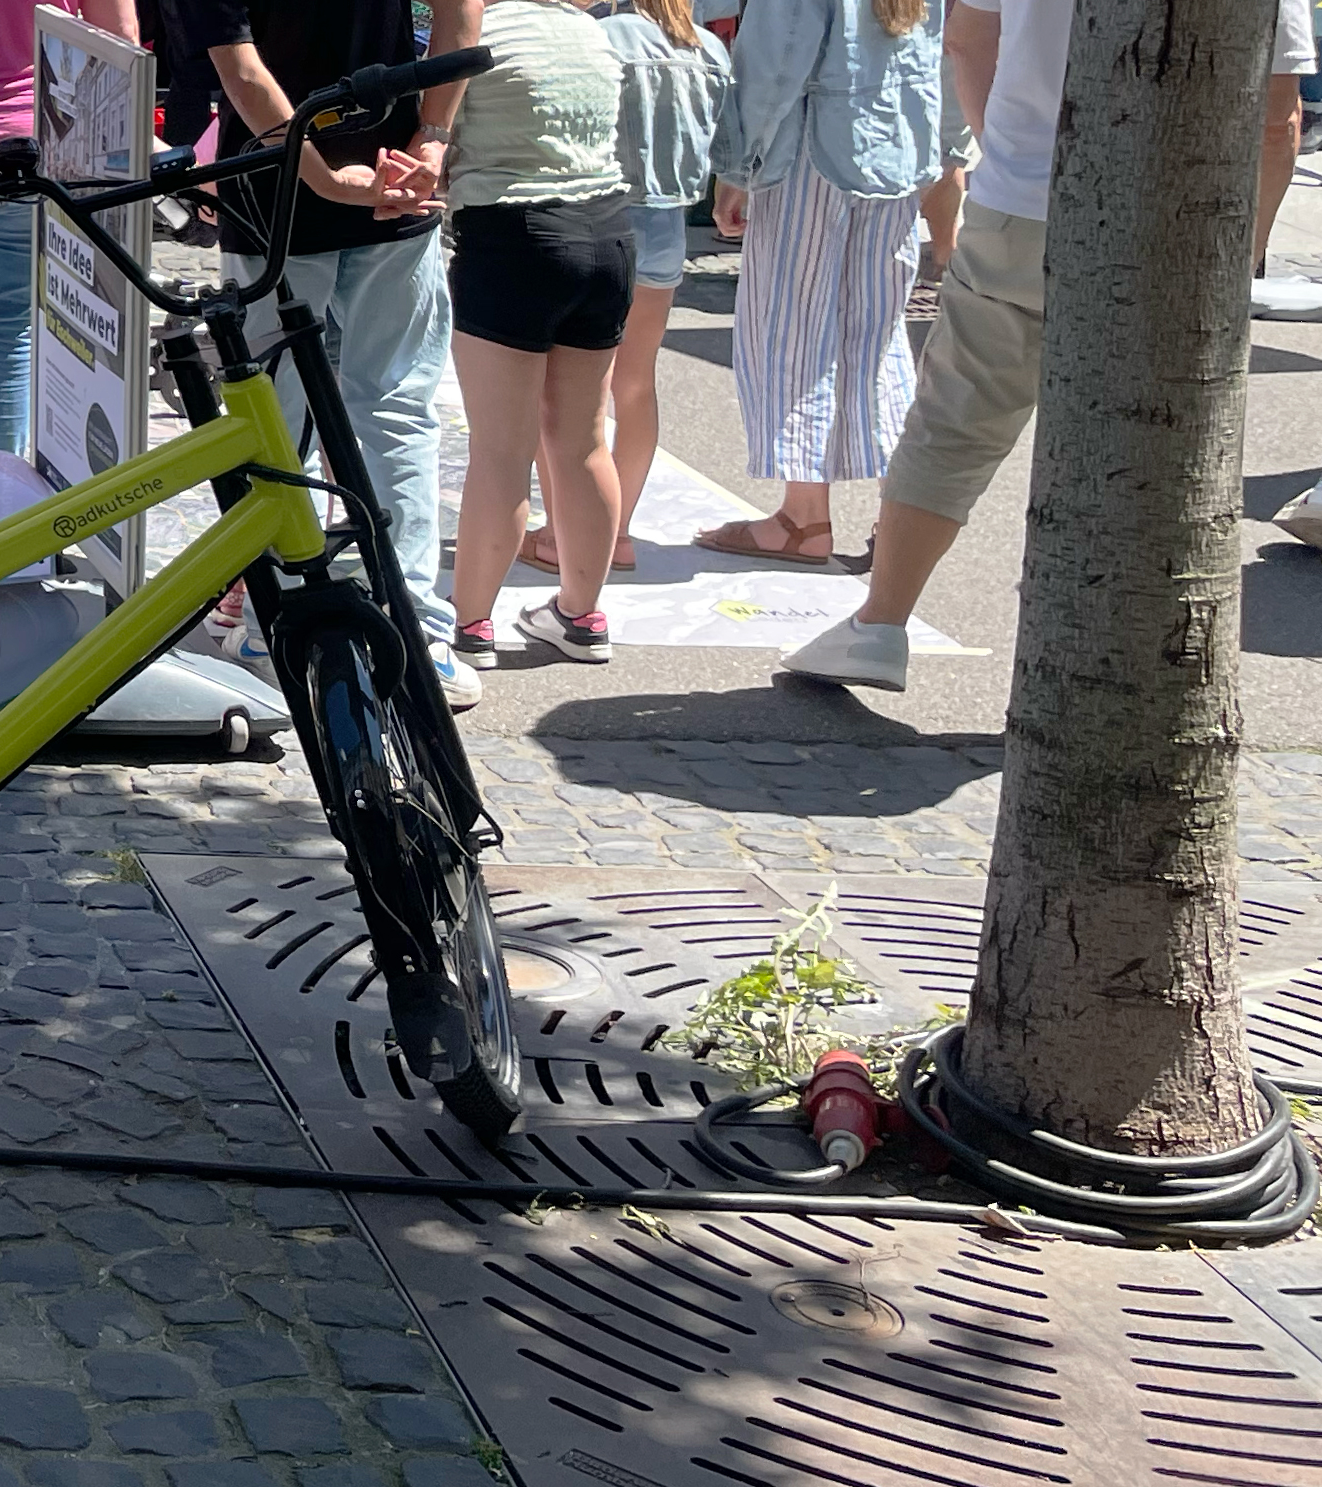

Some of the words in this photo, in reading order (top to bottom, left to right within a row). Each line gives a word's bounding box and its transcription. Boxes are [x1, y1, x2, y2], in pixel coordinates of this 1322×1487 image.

[48, 222, 67, 261] Ihre
[69, 236, 92, 281] Idee
[47, 263, 59, 302] ist
[61, 279, 116, 348] Mehrwert
[53, 477, 164, 539] Radkutsche
